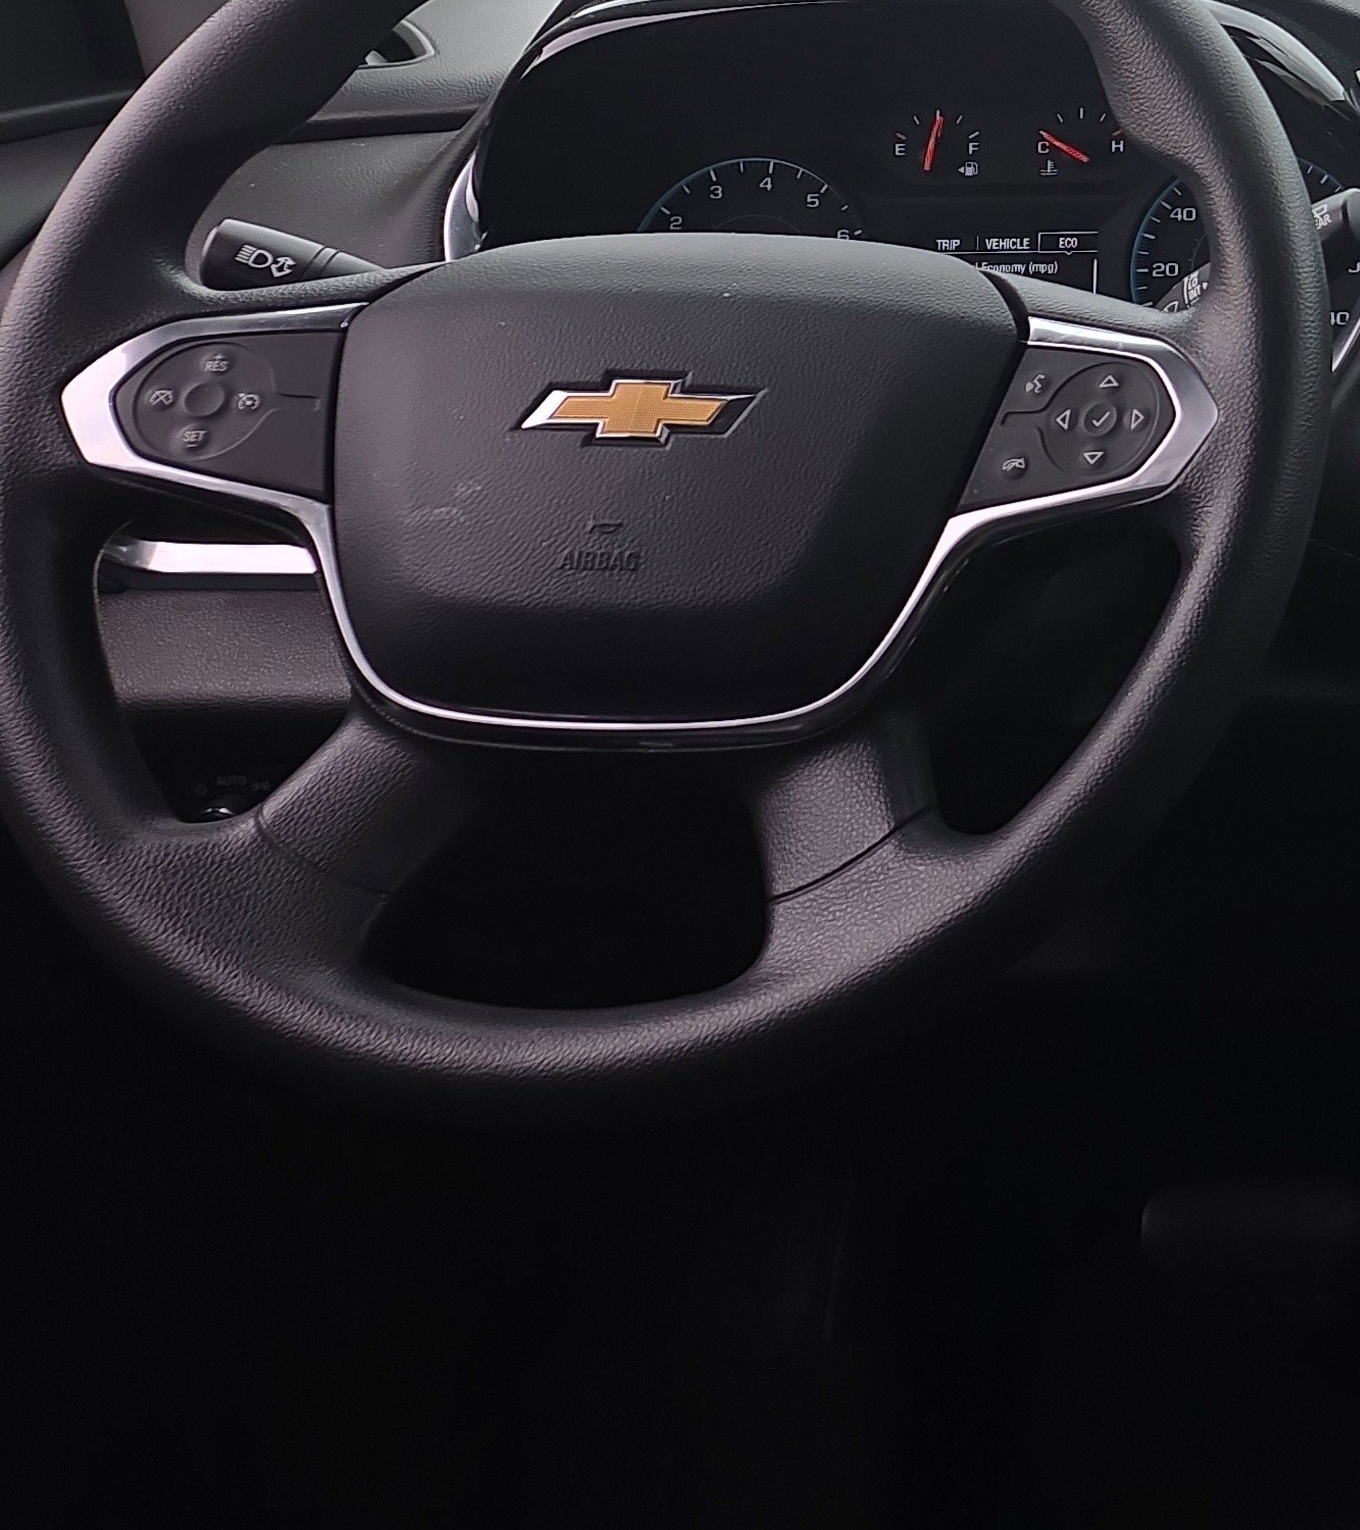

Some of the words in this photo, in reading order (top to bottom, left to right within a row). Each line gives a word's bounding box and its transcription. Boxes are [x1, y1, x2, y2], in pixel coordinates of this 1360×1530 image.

[895, 142, 906, 156] E
[969, 142, 980, 156] F
[1037, 141, 1050, 154] C
[1112, 140, 1124, 154] H
[759, 176, 772, 192] 4
[710, 186, 723, 200] 3
[806, 194, 820, 208] 5
[1169, 207, 1197, 222] 40
[669, 216, 683, 230] 2
[936, 239, 961, 251] TRIP
[985, 237, 1031, 250] VEHICLE
[1059, 237, 1078, 249] ECO
[1028, 260, 1059, 276] (mpg)
[1151, 262, 1179, 277] 20
[556, 549, 641, 571] AIRBAG
